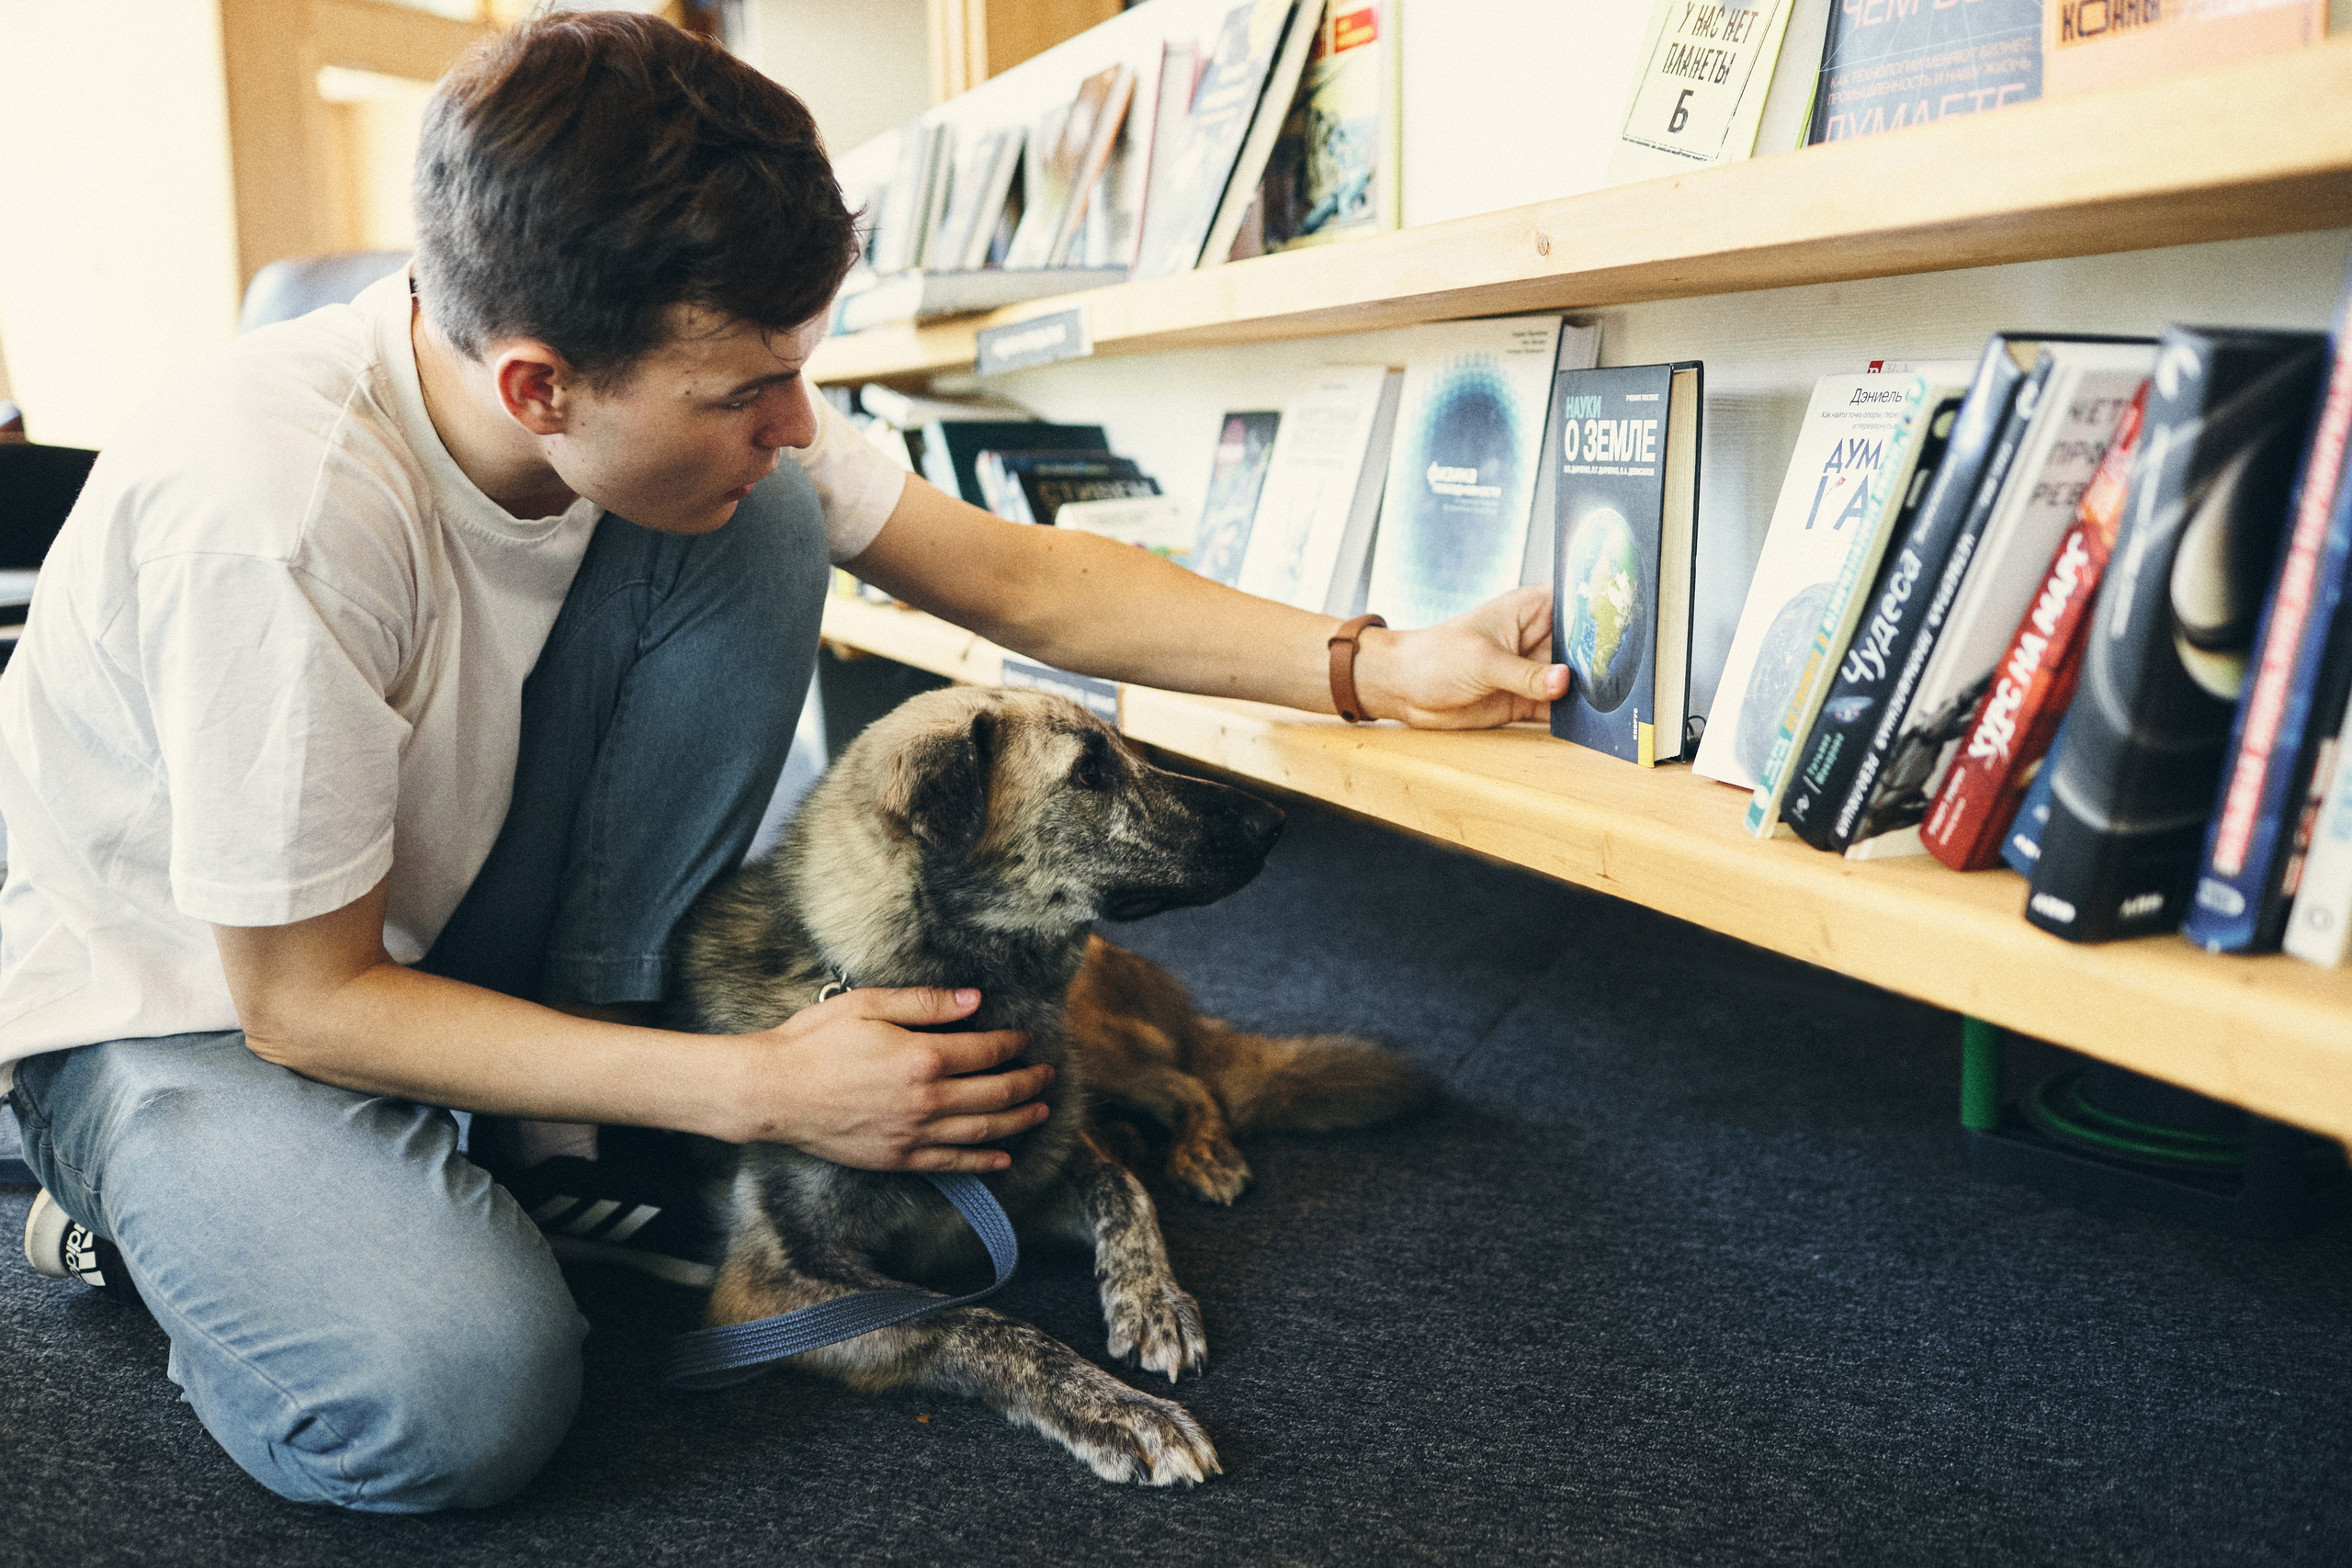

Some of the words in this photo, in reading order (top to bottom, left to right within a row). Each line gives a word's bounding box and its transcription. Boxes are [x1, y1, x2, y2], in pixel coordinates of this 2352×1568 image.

[1678, 2, 1696, 33] У
[1691, 4, 1725, 39] НАС
[1722, 8, 1759, 44] НЕТ
[1662, 42, 1736, 85] ПЛАНЕТЫ
[1851, 60, 1925, 85] ТЕХНОЛОГИИ
[1668, 88, 1695, 134] Б
[1566, 395, 1601, 419] НАУКИ
[1849, 388, 1903, 406] Дэниель
[1849, 412, 1862, 420] точку
[1565, 419, 1579, 462] О
[1583, 419, 1657, 462] ЗЕМЛЕ
[1823, 437, 1883, 474] ДУМ
[1841, 548, 1923, 682] Чудеса
[2007, 631, 2048, 684] НА
[2031, 531, 2088, 637] МАРС
